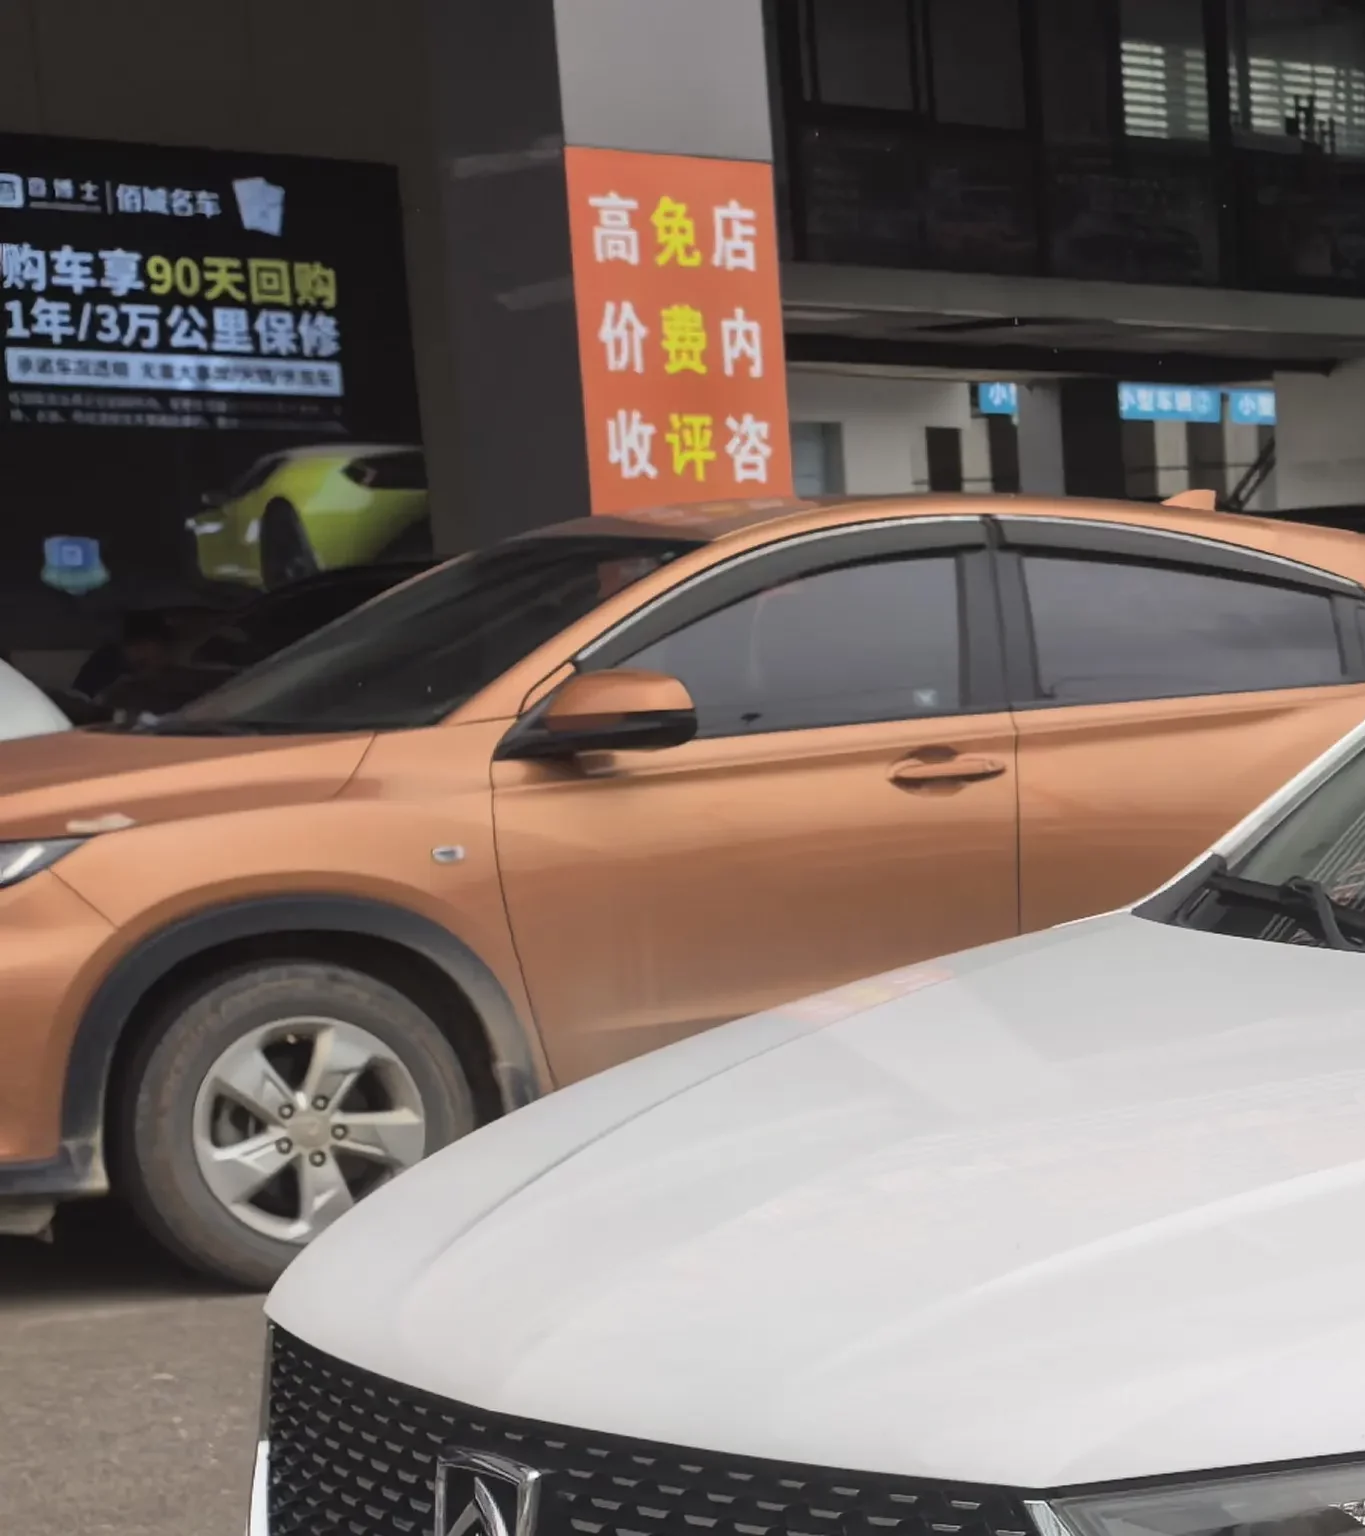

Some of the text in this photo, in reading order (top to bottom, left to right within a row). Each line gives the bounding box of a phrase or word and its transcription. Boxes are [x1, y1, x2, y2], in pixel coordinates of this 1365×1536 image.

[0, 242, 338, 309] 购车享90天回购
[5, 297, 342, 357] 1年/3万公里保修
